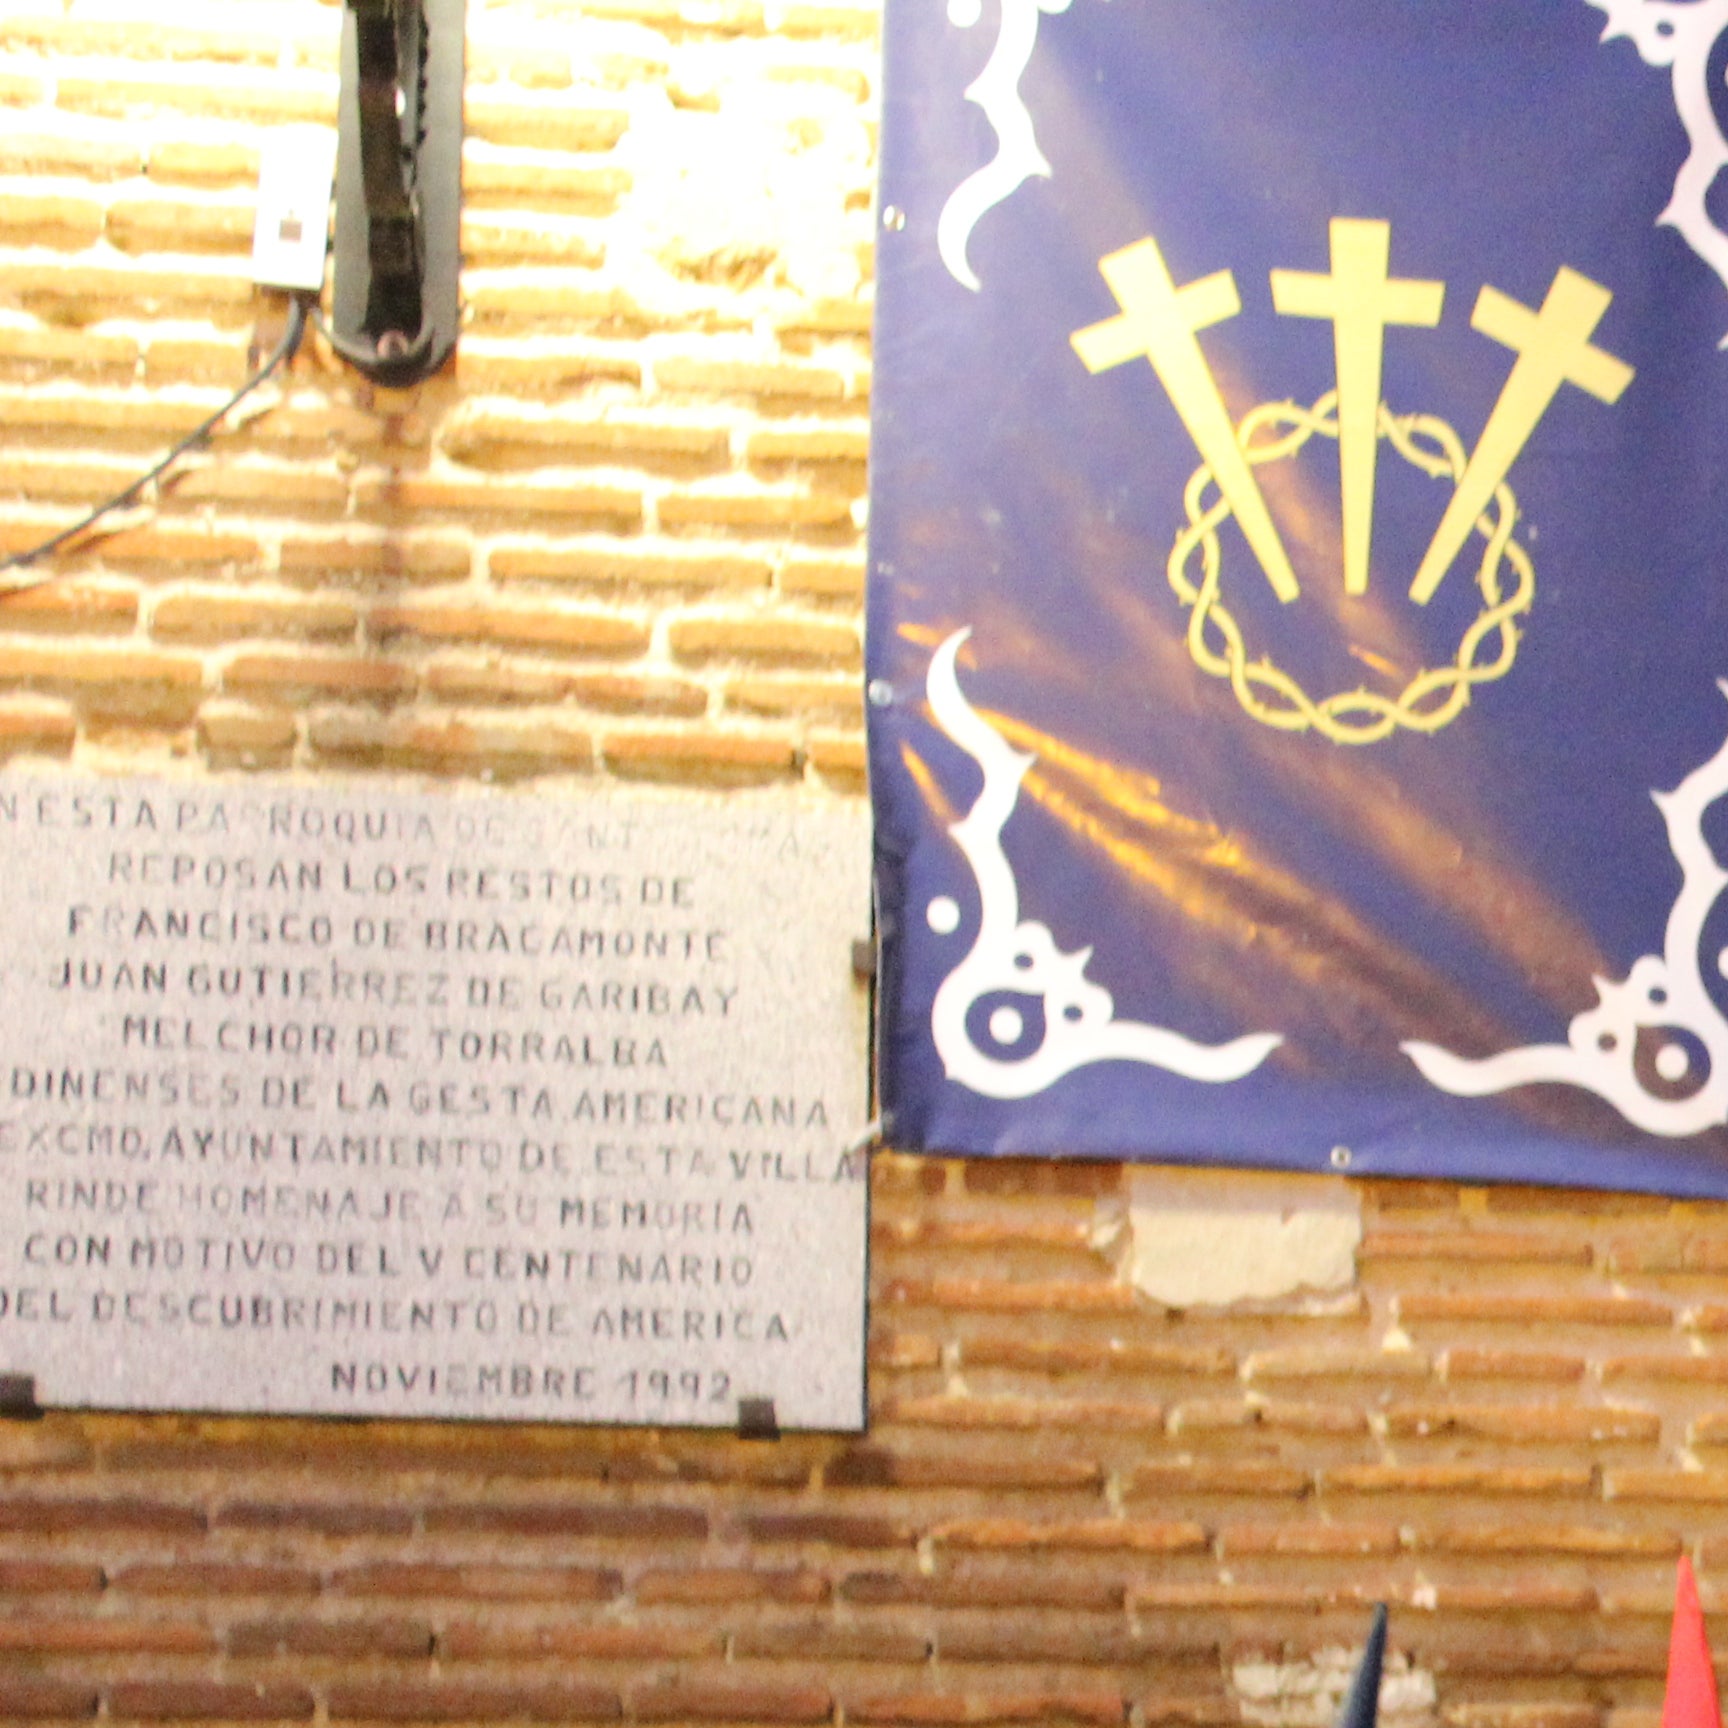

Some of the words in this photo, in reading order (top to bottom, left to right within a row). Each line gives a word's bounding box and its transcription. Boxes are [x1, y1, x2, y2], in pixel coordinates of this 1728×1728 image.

[37, 795, 157, 829] ESTA
[109, 851, 323, 893] REPOSAN
[343, 862, 428, 896] LOS
[447, 868, 622, 906] RESTOS
[639, 877, 695, 907] DE
[68, 906, 332, 947] FRANCISCO
[353, 917, 405, 950] DE
[424, 919, 728, 962] BRACAMONTE
[51, 957, 168, 993] JUAN
[187, 961, 449, 1005] GUTIERREZ
[467, 976, 519, 1010] DE
[540, 980, 739, 1016] GARIBAY
[122, 1014, 336, 1055] MELCHOR
[356, 1025, 410, 1059] DE
[433, 1027, 668, 1067] TORRALBA
[261, 1075, 316, 1109] DE
[337, 1079, 391, 1114] LA
[409, 1080, 552, 1119] GESTA
[572, 1087, 828, 1127] AMERICANA
[161, 1123, 501, 1171] AYUNTAMIENTO
[520, 1139, 572, 1175] DE
[594, 1143, 709, 1177] ESTA
[730, 1149, 857, 1183] VILLA
[26, 1178, 158, 1214] RINDE
[178, 1181, 419, 1223] HOMENAJE
[443, 1191, 463, 1226] A
[485, 1193, 537, 1227] SU
[559, 1197, 754, 1235] MEMORIA
[24, 1233, 112, 1268] CON
[130, 1235, 296, 1273] MOTIVO
[317, 1242, 400, 1277] DEL
[420, 1246, 442, 1277] V
[463, 1246, 754, 1286] CENTENARIO
[91, 1289, 497, 1335] DESCUBRIMIENTO
[517, 1303, 571, 1337] DE
[592, 1306, 789, 1342] AMERICA
[331, 1362, 596, 1398] NOVIEMBRE
[617, 1366, 731, 1400] 1992
